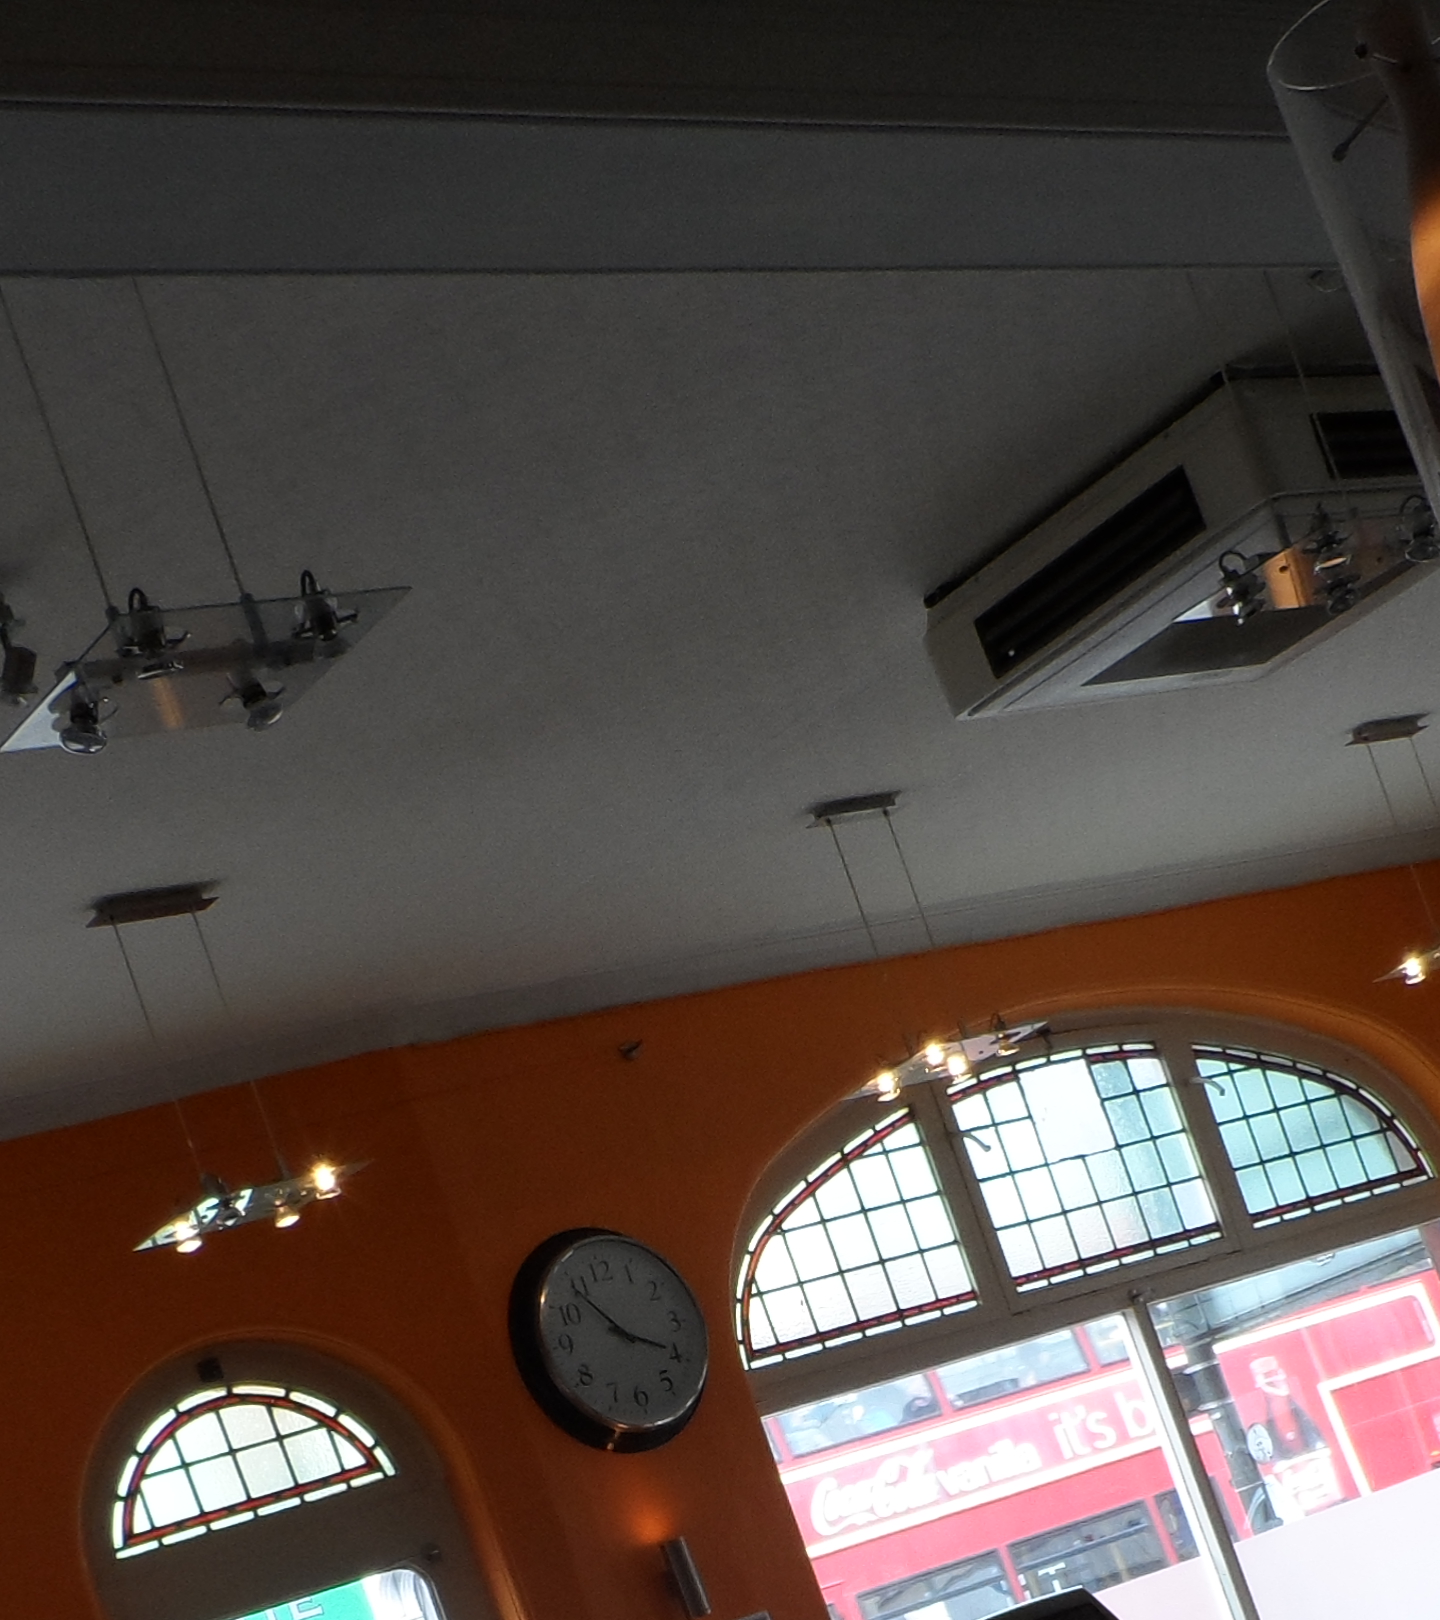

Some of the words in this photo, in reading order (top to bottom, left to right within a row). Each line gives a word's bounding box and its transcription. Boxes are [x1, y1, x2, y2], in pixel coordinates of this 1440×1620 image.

[588, 1260, 613, 1282] 12
[624, 1263, 635, 1284] 1
[646, 1281, 661, 1302] 2
[559, 1303, 581, 1326] 10
[667, 1310, 681, 1332] 3
[558, 1333, 574, 1355] 9
[669, 1342, 682, 1363] 4
[578, 1364, 593, 1386] 8
[659, 1369, 673, 1392] 5
[606, 1382, 619, 1403] 7
[633, 1386, 649, 1407] 6
[935, 1438, 1042, 1496] vanilla
[1048, 1404, 1117, 1460] it's
